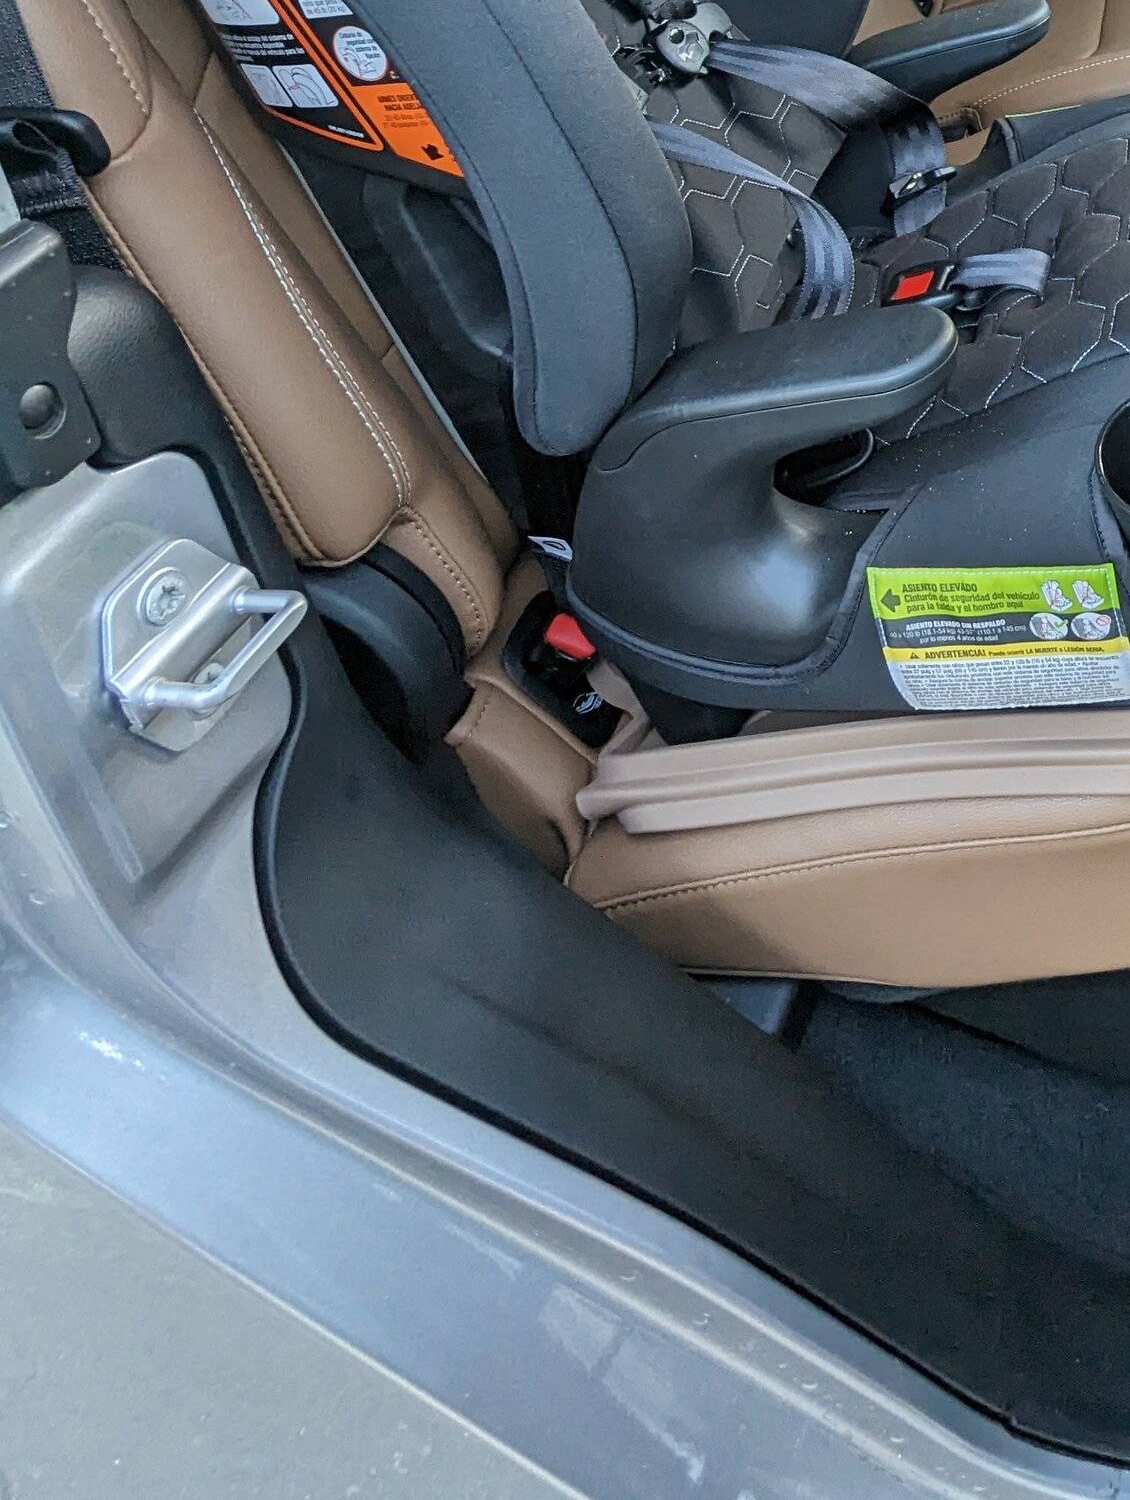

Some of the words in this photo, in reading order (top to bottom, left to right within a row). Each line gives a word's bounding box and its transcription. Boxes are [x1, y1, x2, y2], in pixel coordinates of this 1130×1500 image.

[902, 583, 937, 593] ASIENTO
[940, 582, 978, 592] ELEVADO
[904, 592, 938, 602] Cinturón
[939, 593, 949, 602] de
[951, 592, 990, 603] seguridad
[992, 591, 1005, 600] del
[907, 604, 926, 614] para
[926, 601, 935, 610] la
[936, 602, 956, 612] falda
[957, 604, 962, 613] y
[963, 603, 972, 612] el
[973, 600, 1005, 611] hombro
[906, 621, 932, 631] ASIENTO
[933, 620, 960, 628] ELEVADO
